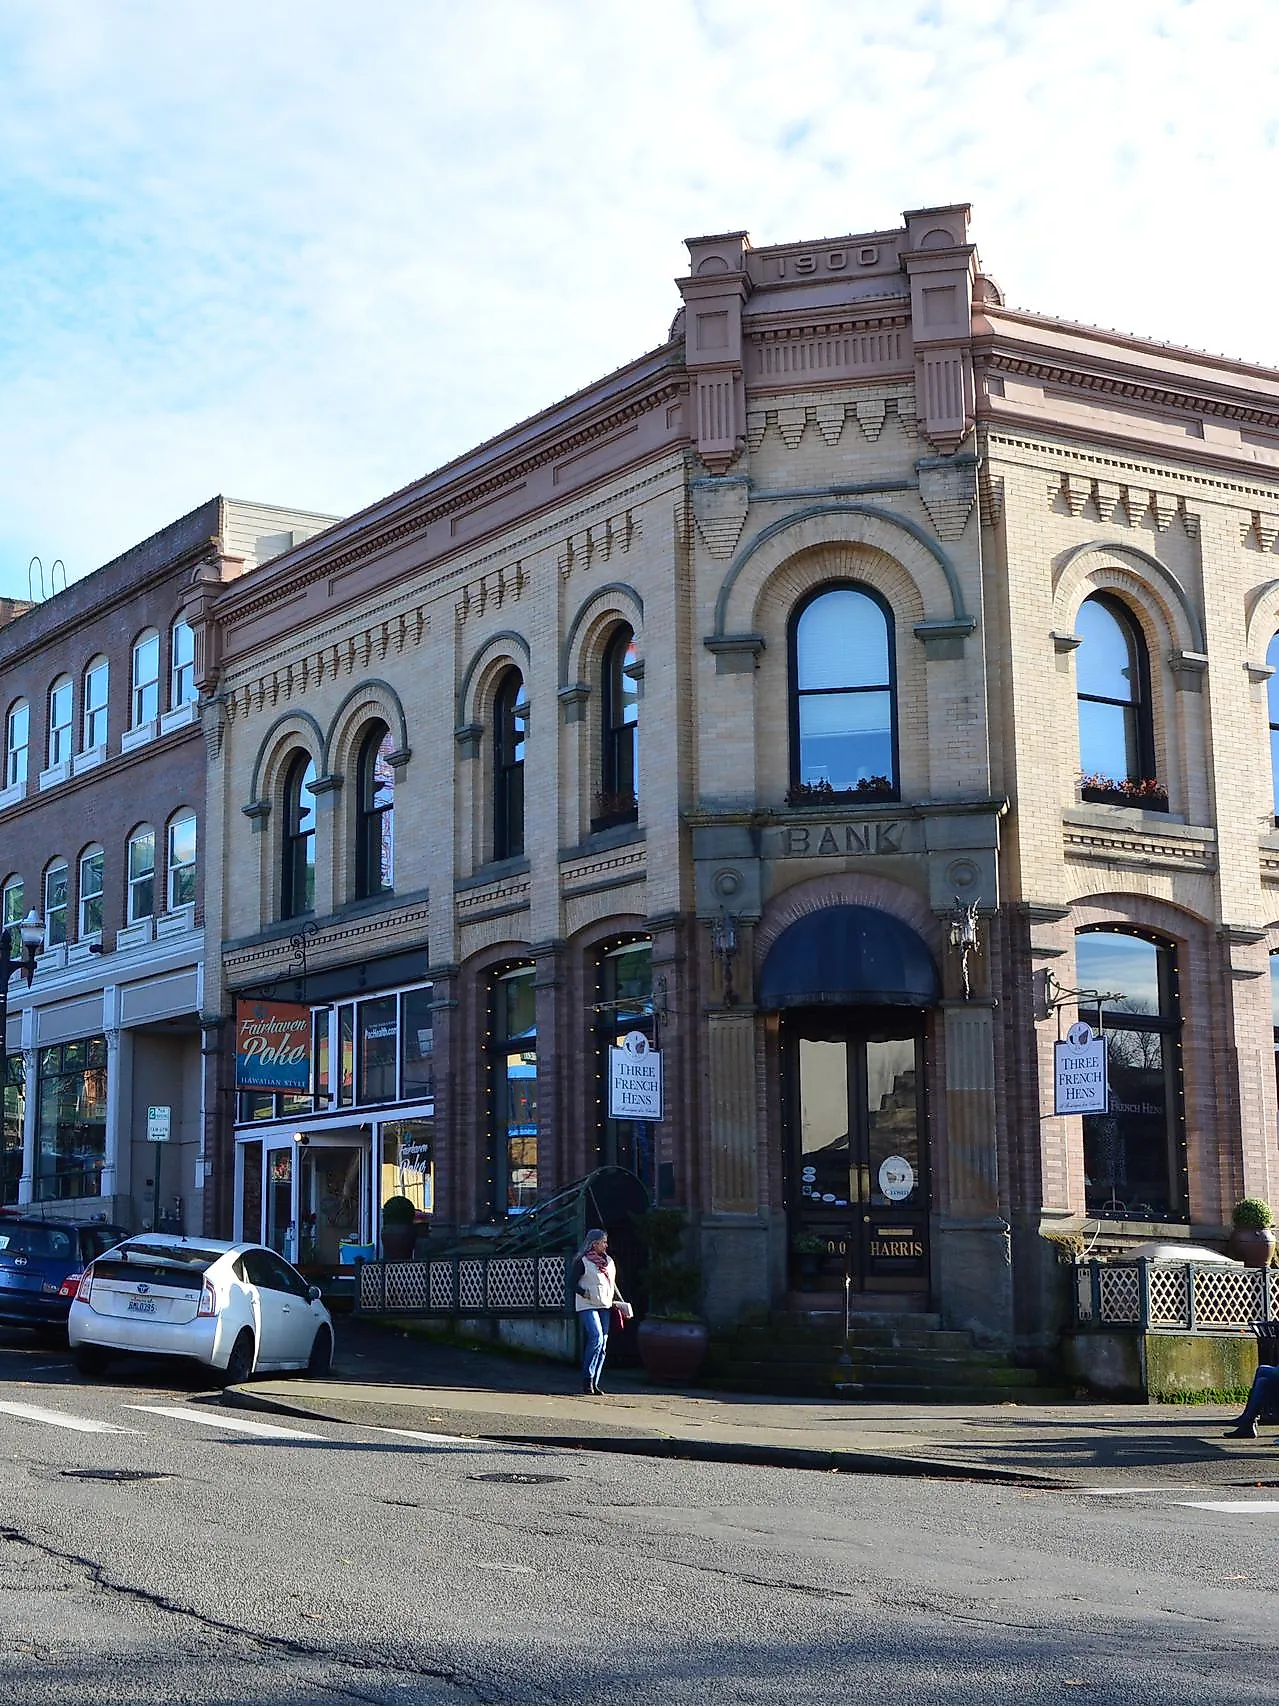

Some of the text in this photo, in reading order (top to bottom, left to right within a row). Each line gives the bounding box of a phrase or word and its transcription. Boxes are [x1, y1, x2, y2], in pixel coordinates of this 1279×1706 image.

[779, 244, 879, 278] 1900
[787, 822, 900, 854] BANK
[240, 1016, 307, 1035] Fairhaven
[242, 1033, 306, 1067] Poke
[618, 1063, 655, 1077] THREE
[1061, 1056, 1099, 1070] THREE
[615, 1077, 658, 1091] FRENCH
[1057, 1071, 1102, 1086] FRENCH
[622, 1092, 652, 1104] HENS
[1066, 1087, 1096, 1100] HENS
[870, 1241, 923, 1256] HARRIS
